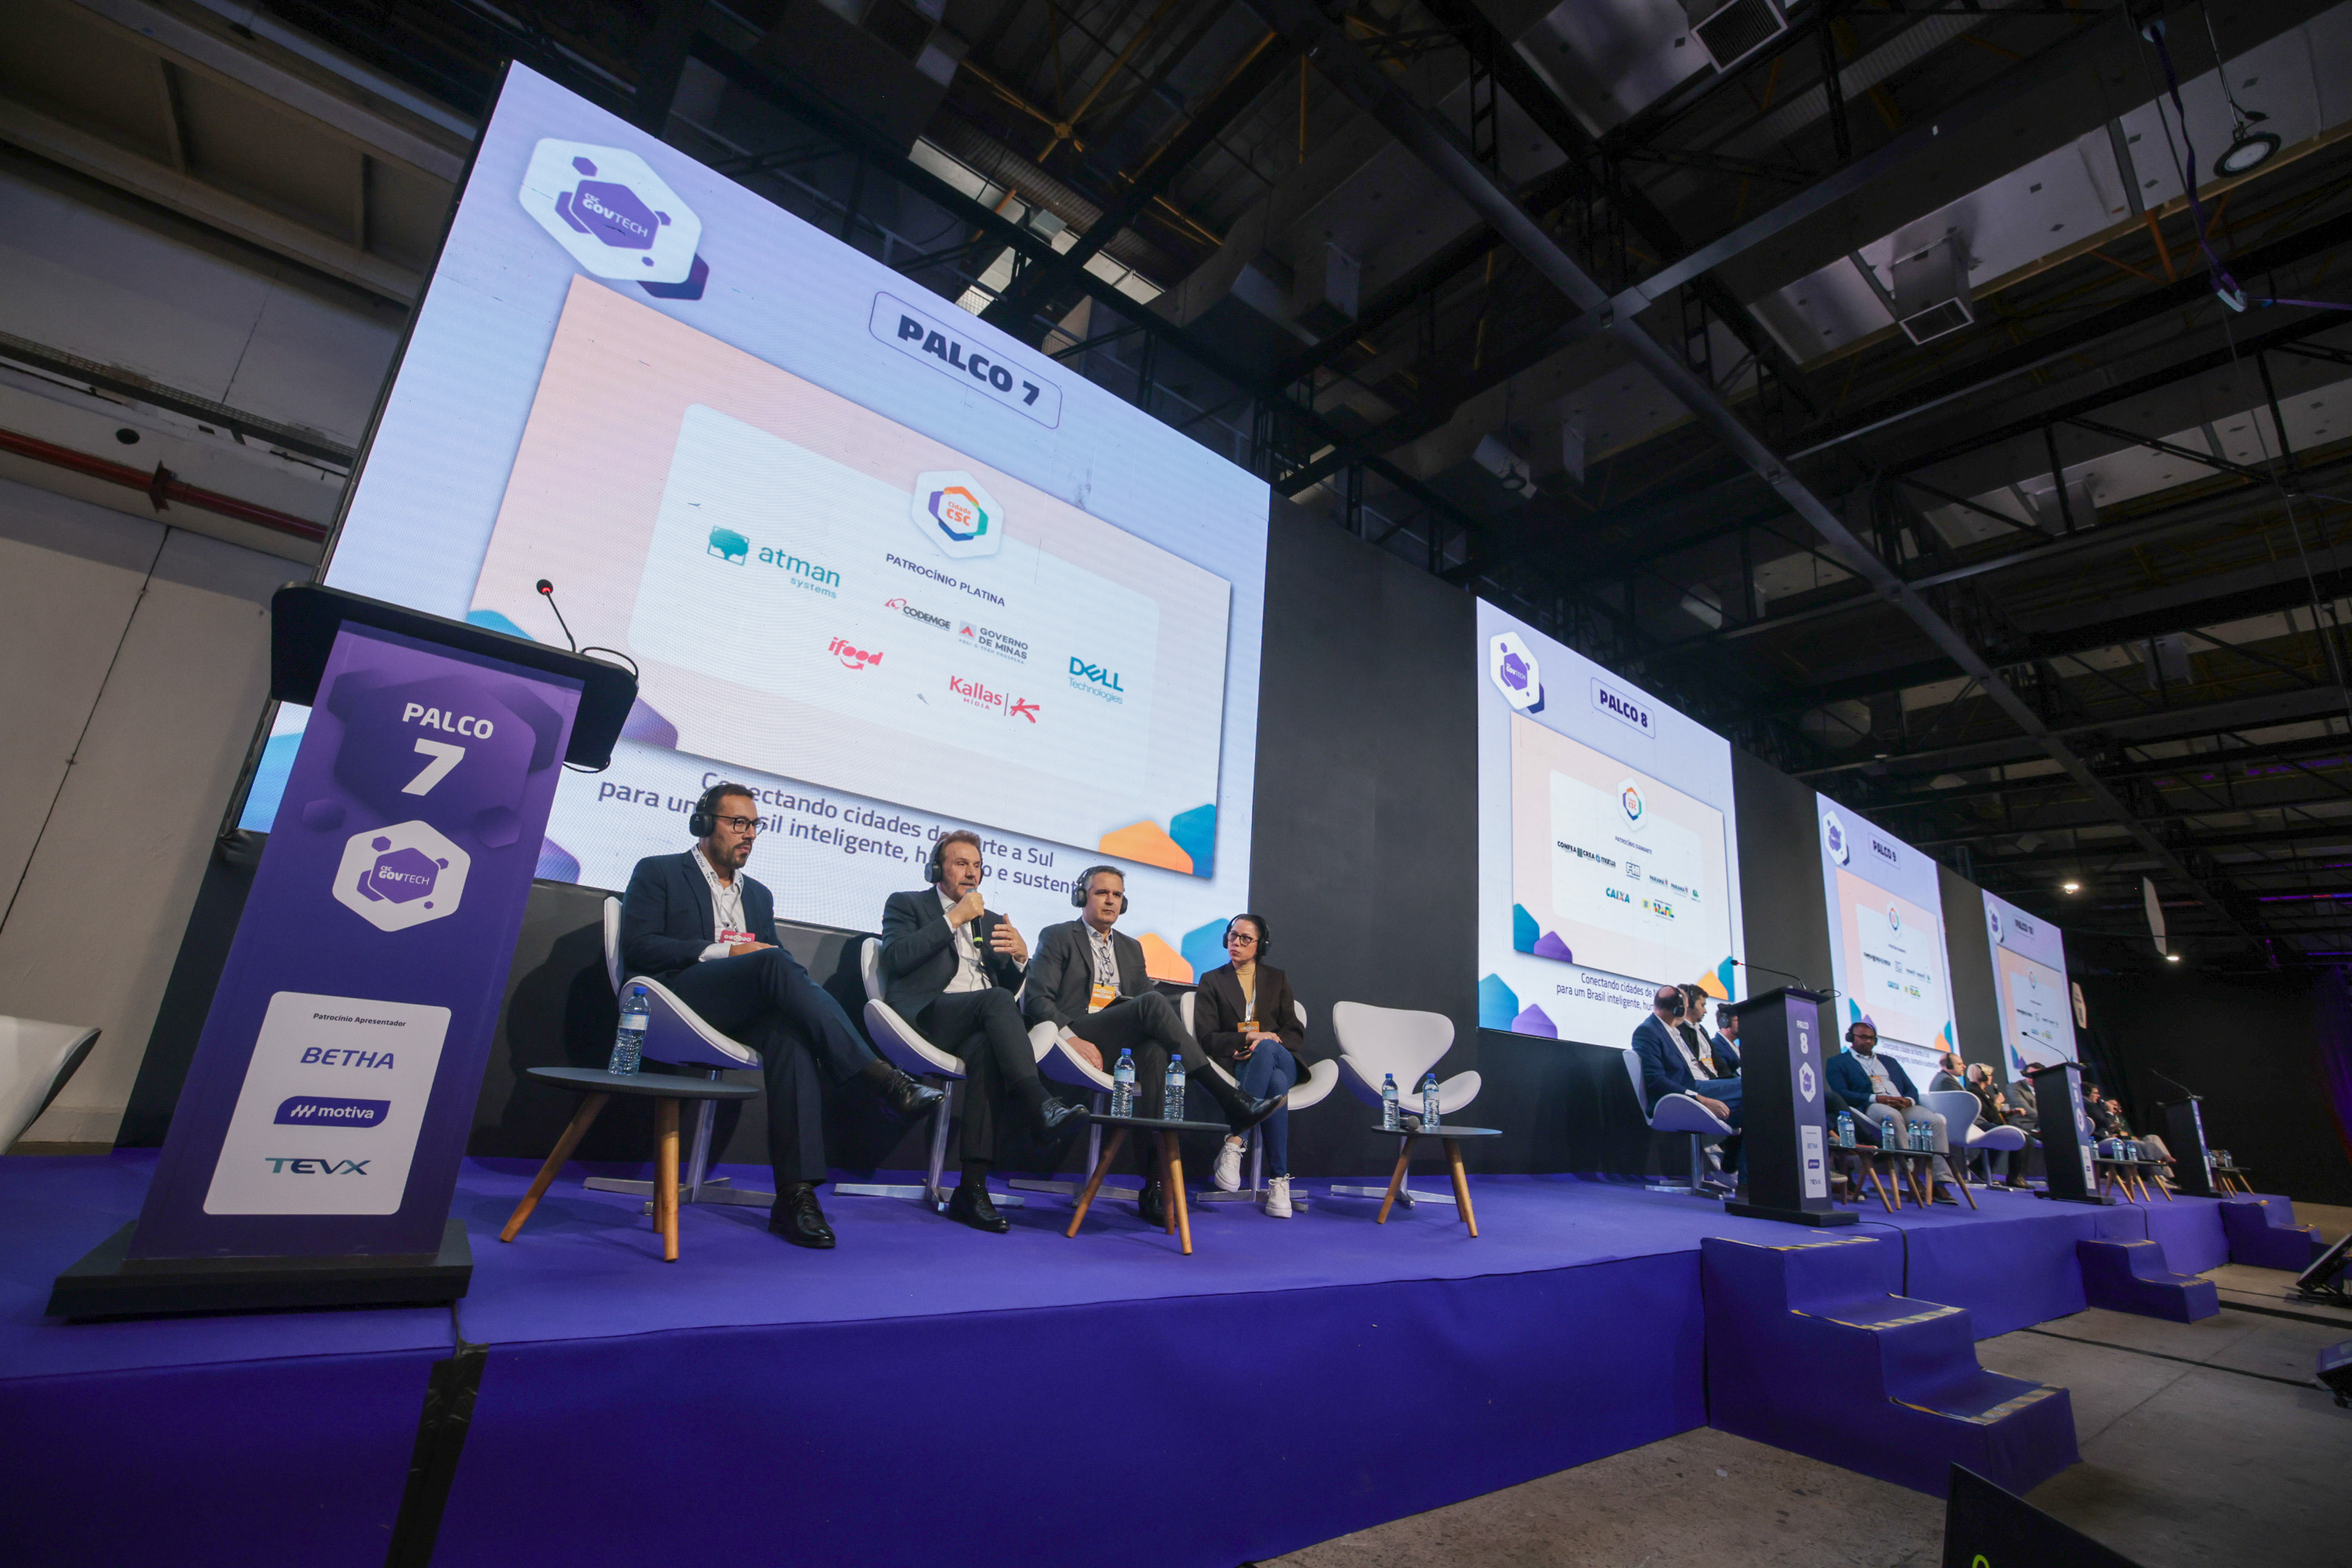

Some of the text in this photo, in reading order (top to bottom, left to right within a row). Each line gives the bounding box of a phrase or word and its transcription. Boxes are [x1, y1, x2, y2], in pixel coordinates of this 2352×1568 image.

[582, 198, 648, 238] GOVTECH
[898, 314, 1040, 406] PALCO 7
[946, 508, 971, 527] CSC
[758, 546, 840, 587] atman
[790, 577, 837, 599] systems
[886, 554, 1005, 607] PATROCÍNIO PLATINA
[902, 606, 951, 630] CODEMGE
[978, 636, 1028, 659] DE MINAS
[980, 627, 1029, 650] GOVERNO
[1069, 656, 1123, 692] DELL
[949, 676, 1003, 706] Kallas
[1068, 676, 1123, 704] Technologies
[964, 697, 990, 710] MÍDIA
[1599, 688, 1648, 728] PALCO 8
[401, 702, 494, 739] PALCO
[401, 738, 466, 797] 7
[598, 782, 659, 808] para
[789, 818, 908, 862] inteligente,
[997, 868, 1007, 880] e
[844, 806, 921, 837] cidades
[1011, 847, 1022, 860] a
[1027, 848, 1054, 867] Sul
[1557, 840, 1577, 853] CONFEA
[1583, 850, 1595, 859] CREA
[1873, 840, 1892, 859] PALCO
[379, 870, 430, 885] GOVTECH
[1606, 887, 1630, 903] CAIXA
[1556, 984, 1573, 995] para
[1574, 988, 1585, 997] um
[1588, 988, 1606, 1002] Brasil
[1607, 993, 1642, 1010] inteligente,
[1581, 973, 1619, 990] Conectando
[1621, 982, 1643, 996] cidades
[1645, 987, 1652, 998] de
[313, 1013, 407, 1027] Patrocínio Apresentador
[1800, 1032, 1809, 1054] 8
[300, 1047, 394, 1069] BETHA
[318, 1105, 375, 1119] motiva
[265, 1157, 372, 1175] TEVX
